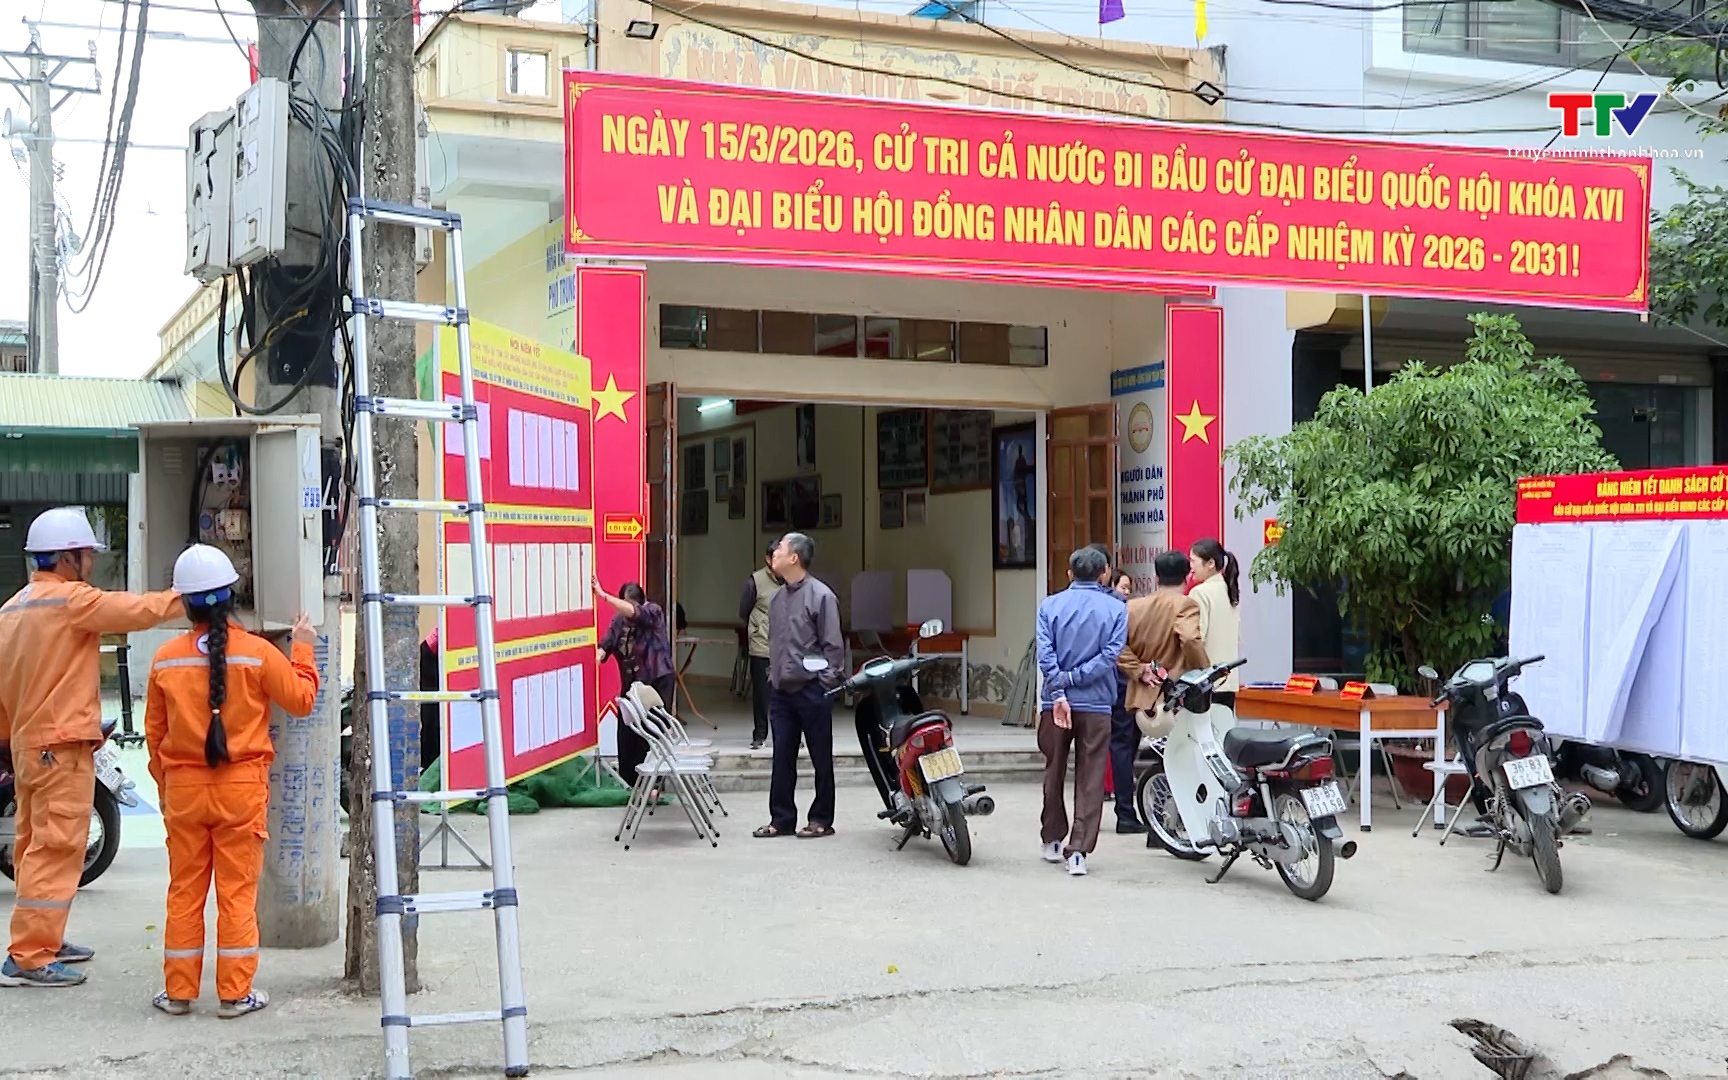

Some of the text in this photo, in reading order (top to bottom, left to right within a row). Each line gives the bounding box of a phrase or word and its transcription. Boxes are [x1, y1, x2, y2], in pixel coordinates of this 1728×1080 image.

[602, 110, 1625, 226] NGÀY 15/3/2026, CỬ TRI CẢ NƯỚC ĐI BẦU CỬ ĐẠI BIỂU QUỐC HỘI KHÓA XVI
[657, 178, 700, 225] VÀ
[708, 186, 763, 237] ĐẠI
[772, 179, 843, 234] BIỂU
[853, 190, 904, 244] HỘI
[912, 189, 995, 243] ĐỒNG
[1003, 201, 1086, 249] NHÂN
[1094, 204, 1153, 252] DÂN
[1160, 214, 1217, 256] CÁC
[1224, 208, 1281, 260] CẤP
[1287, 219, 1375, 270] NHIỆM
[1381, 226, 1417, 267] KỲ
[1422, 234, 1486, 272] 2026
[1508, 241, 1581, 278] 2031!
[1146, 463, 1163, 480] DÂN
[1684, 473, 1709, 494] SÁCH
